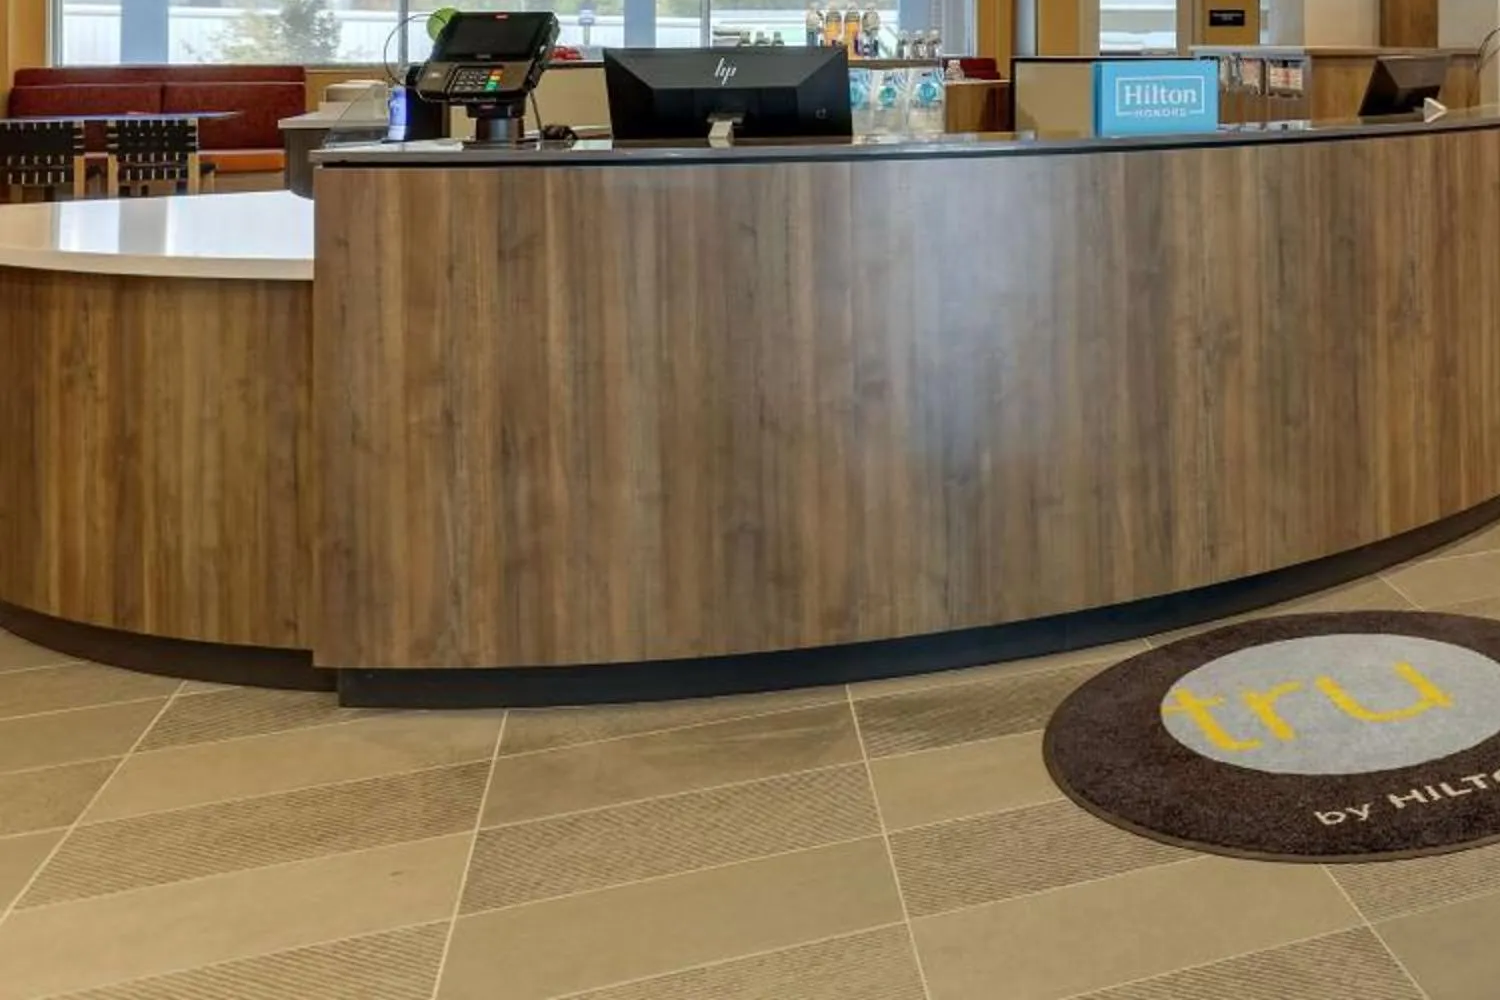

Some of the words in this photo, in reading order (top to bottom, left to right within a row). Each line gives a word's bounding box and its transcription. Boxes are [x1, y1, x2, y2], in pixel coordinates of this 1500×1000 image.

[714, 57, 738, 85] hp
[1124, 84, 1198, 106] Hilton
[1136, 107, 1187, 118] HONORS
[1161, 661, 1453, 752] tru
[1314, 803, 1371, 825] by
